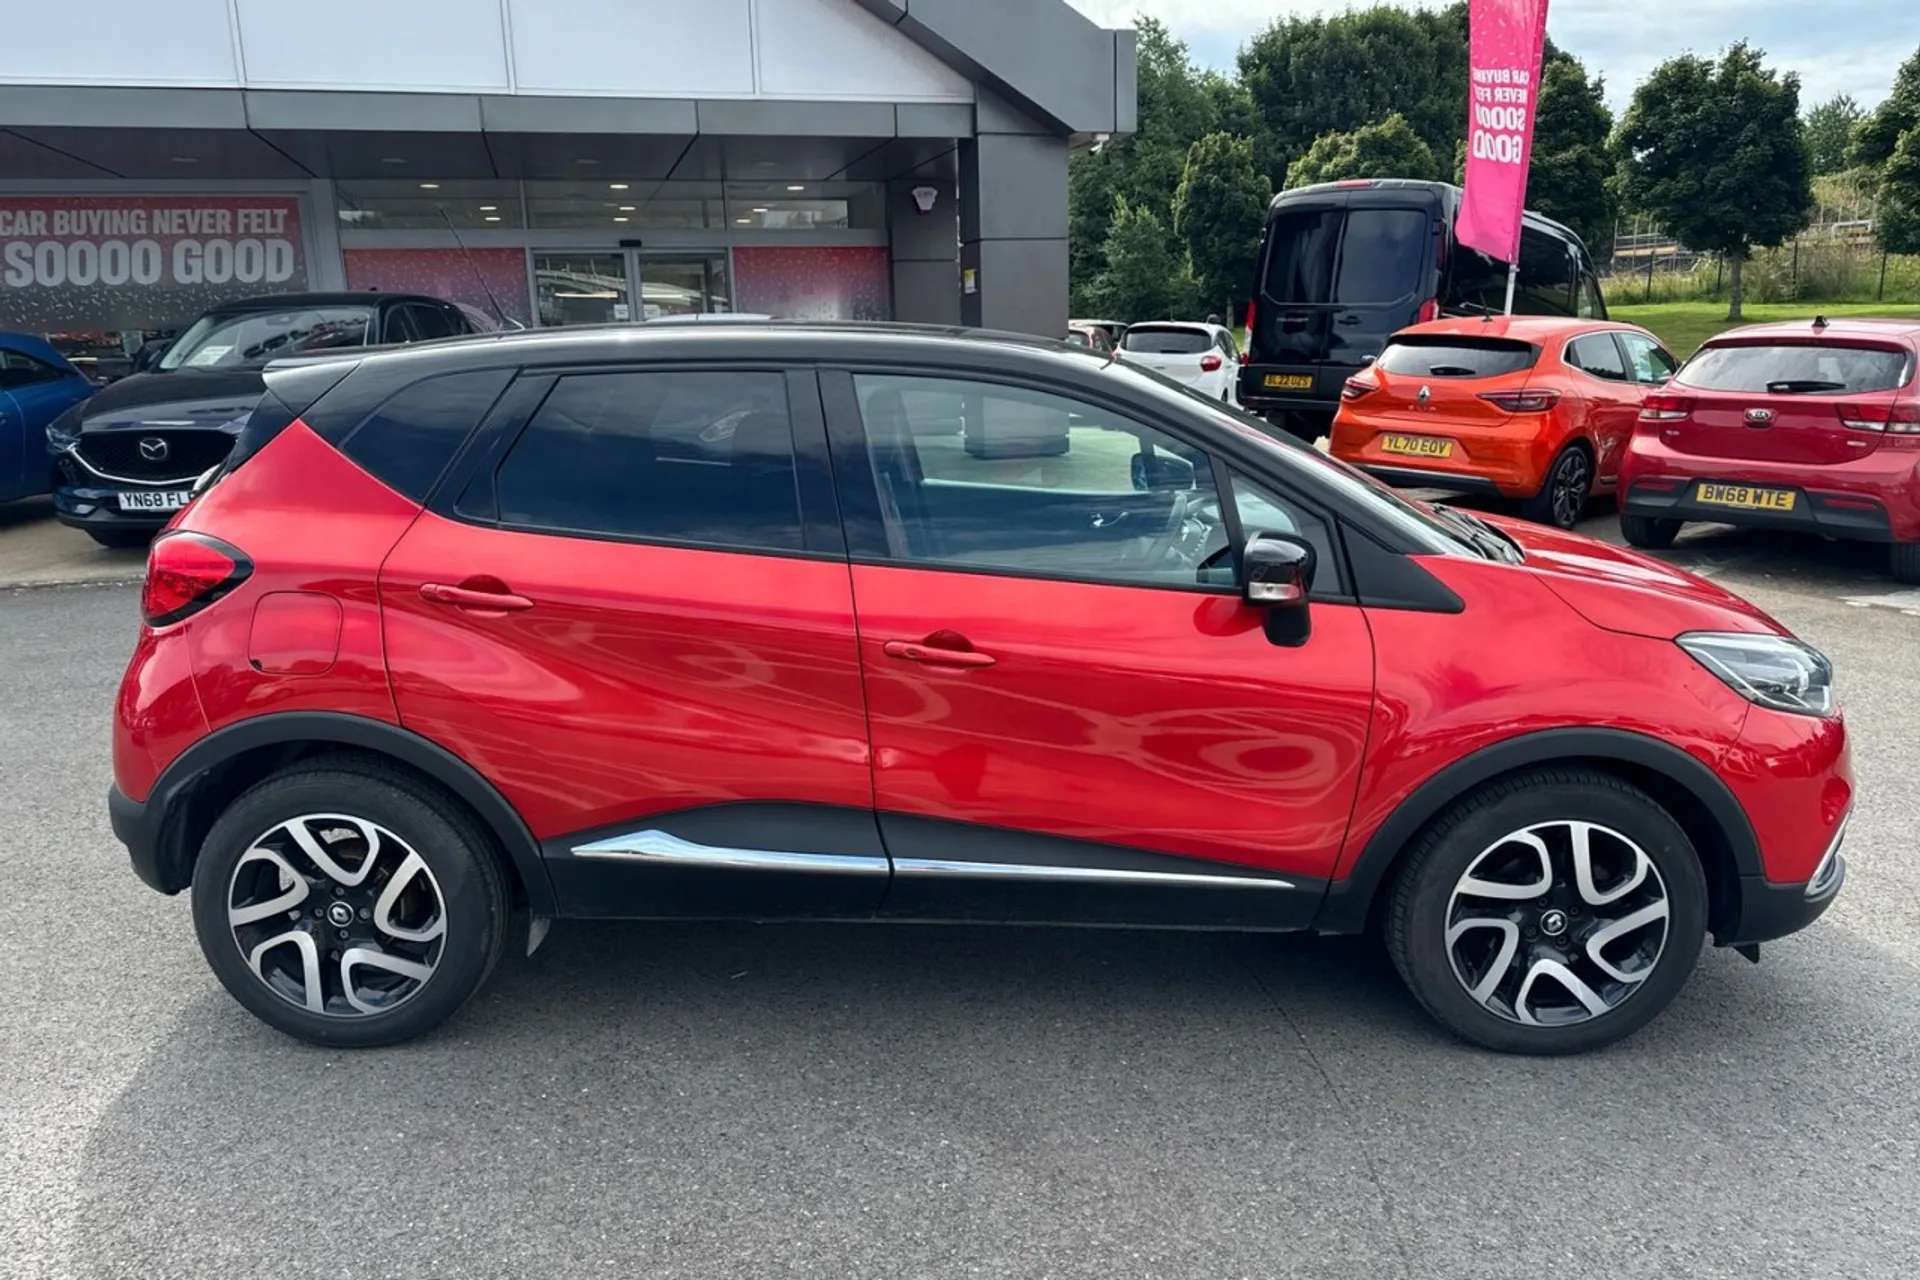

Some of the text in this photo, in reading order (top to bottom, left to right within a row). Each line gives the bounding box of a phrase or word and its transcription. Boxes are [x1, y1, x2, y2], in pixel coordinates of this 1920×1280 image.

[0, 208, 288, 236] CAR BUYING NEVER FELT
[4, 238, 294, 287] SOOOO GOOD
[1388, 436, 1418, 451] YL70
[124, 493, 163, 507] YN68
[1703, 484, 1788, 507] BW68 WTE
